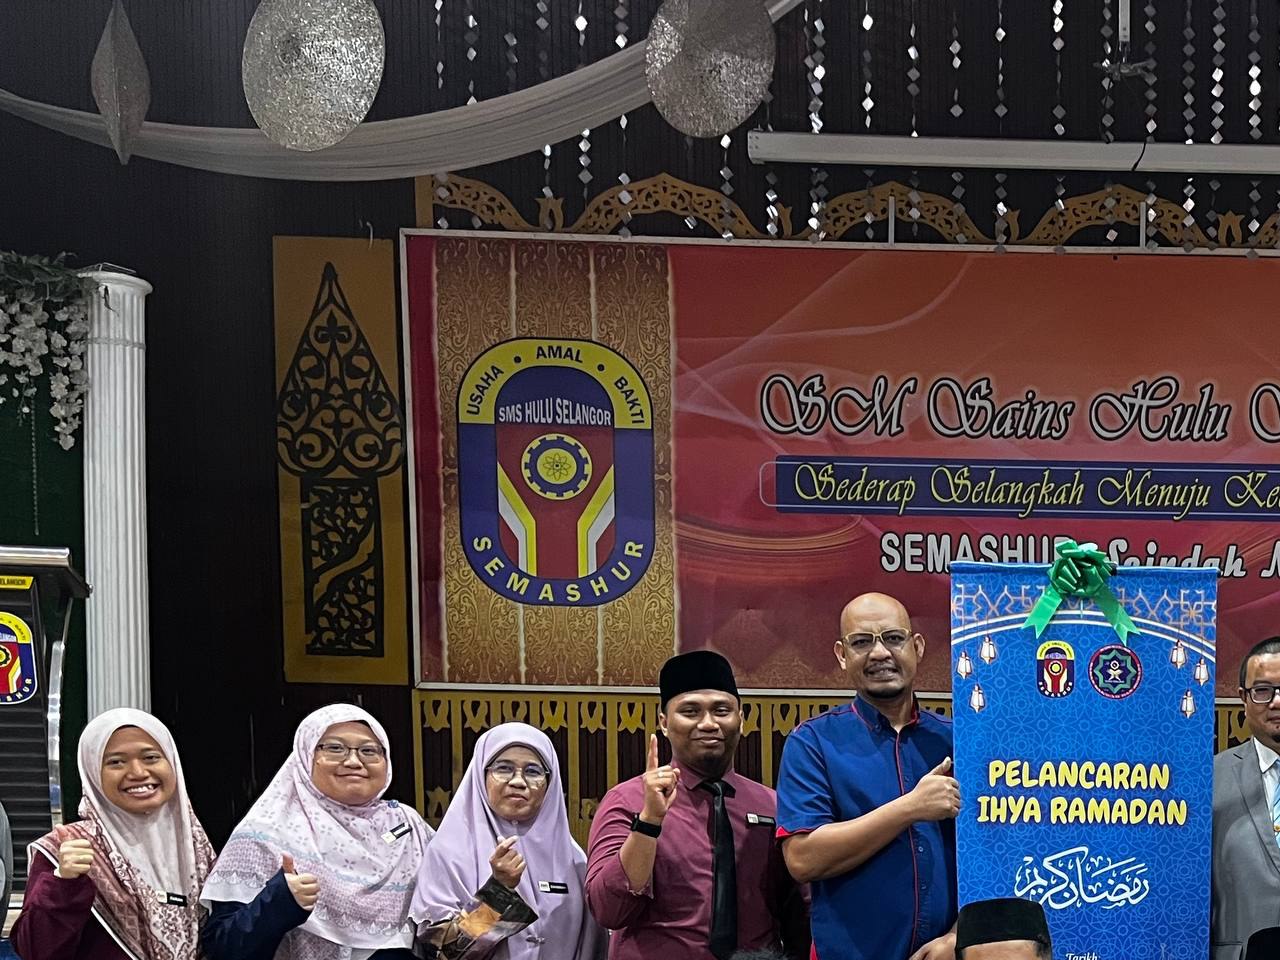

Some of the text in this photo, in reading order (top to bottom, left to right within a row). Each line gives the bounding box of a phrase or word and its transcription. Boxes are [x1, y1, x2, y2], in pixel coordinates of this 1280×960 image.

[465, 344, 647, 426] USAHA AMAL BAKTI
[498, 397, 613, 427] SMS HULU SELANGOR
[760, 373, 918, 440] SM
[928, 375, 1073, 442] Sains
[1089, 375, 1232, 442] Hulu
[794, 461, 918, 516] Sederap
[929, 464, 1085, 518] Selangkah
[1097, 469, 1211, 522] Menuju
[472, 535, 646, 603] SEMASHUR
[988, 759, 1171, 791] PELANCARAN
[976, 795, 1188, 826] IHYA RAMADAN
